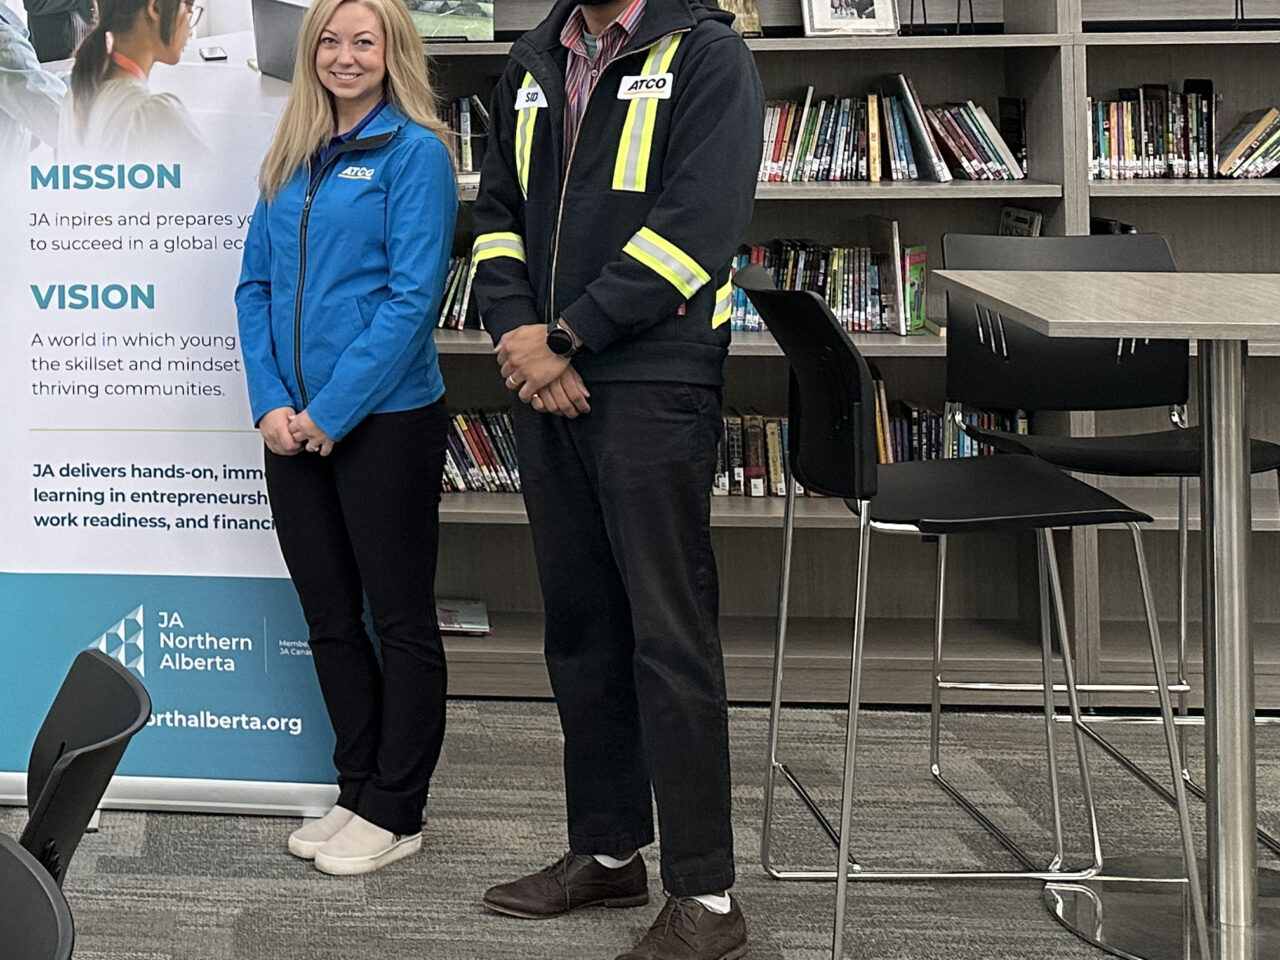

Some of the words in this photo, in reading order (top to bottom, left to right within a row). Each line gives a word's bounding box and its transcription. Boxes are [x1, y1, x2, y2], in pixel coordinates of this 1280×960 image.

[627, 77, 667, 91] ATCO
[525, 92, 538, 103] SID
[30, 163, 181, 190] MISSION
[341, 166, 375, 177] ATCO
[29, 212, 51, 227] JA
[55, 212, 113, 230] inpires
[117, 211, 151, 227] and
[156, 214, 233, 230] prepares
[29, 238, 47, 251] to
[52, 236, 123, 251] succeed
[128, 236, 144, 250] in
[149, 239, 159, 250] a
[163, 235, 218, 254] global
[223, 238, 246, 250] ec
[30, 283, 155, 310] VISION
[31, 332, 44, 347] A
[47, 332, 97, 347] world
[102, 332, 118, 347] in
[122, 332, 176, 347] which
[179, 335, 236, 351] young
[31, 356, 61, 371] the
[65, 356, 124, 372] skillset
[128, 357, 162, 371] and
[167, 356, 241, 372] mindset
[32, 381, 99, 399] thriving
[104, 381, 226, 396] communities.
[32, 463, 56, 478] JA
[59, 462, 127, 478] delivers
[130, 463, 219, 482] hands-on,
[222, 463, 265, 480] imm
[33, 487, 105, 506] learning
[109, 487, 126, 503] in
[130, 489, 268, 508] entrepreneursh
[33, 512, 79, 527] work
[83, 512, 171, 532] readiness,
[174, 513, 209, 529] and
[158, 611, 184, 629] JA
[159, 632, 253, 651] Northern
[279, 639, 310, 648] Membe
[280, 647, 290, 655] JA
[159, 654, 236, 672] Alberta
